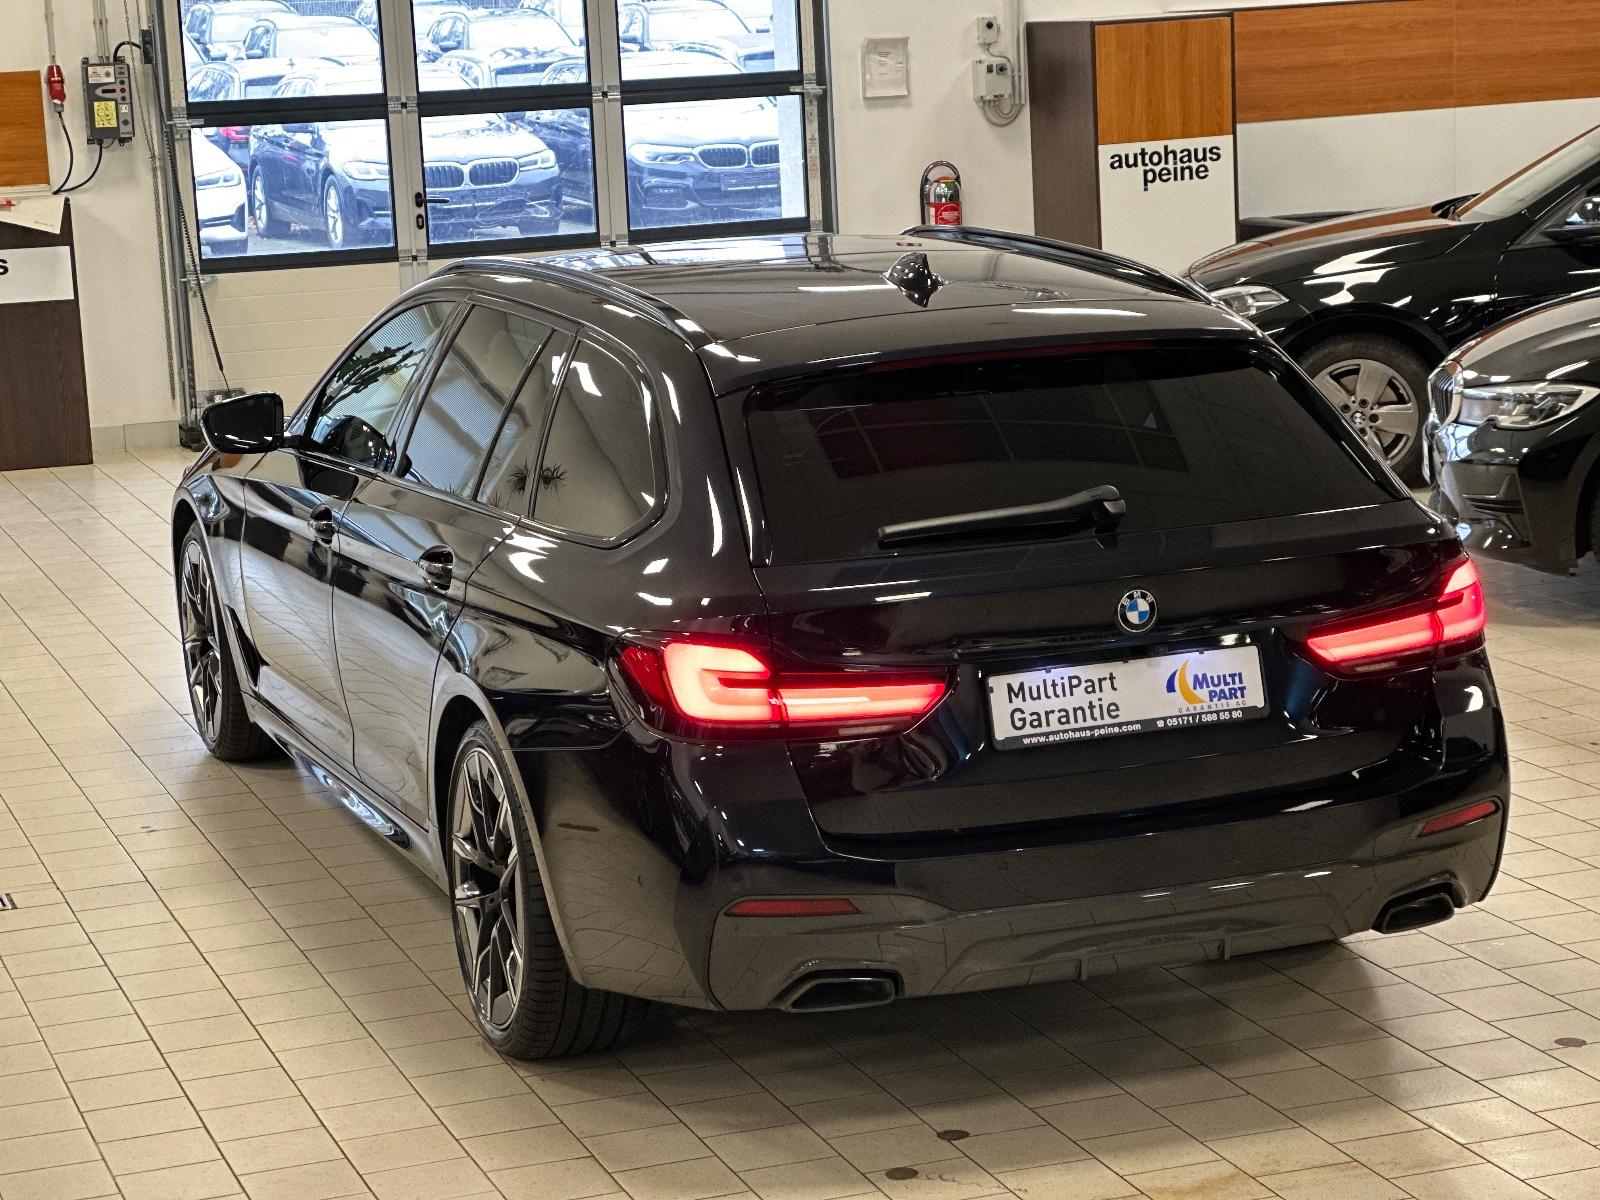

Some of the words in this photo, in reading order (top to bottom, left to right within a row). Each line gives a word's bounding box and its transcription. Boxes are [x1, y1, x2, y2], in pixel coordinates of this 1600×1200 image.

[1109, 145, 1221, 170] autohaus
[1143, 160, 1209, 191] peine
[1006, 672, 1118, 703] MultiPart
[1193, 672, 1244, 690] MULTI
[1208, 686, 1247, 702] PART
[1010, 697, 1120, 731] Garantie
[1178, 701, 1230, 713] GARANTIE
[1166, 716, 1194, 727] 05171
[1231, 710, 1243, 718] 80
[1022, 723, 1142, 745] www.autohaus-peine.com
